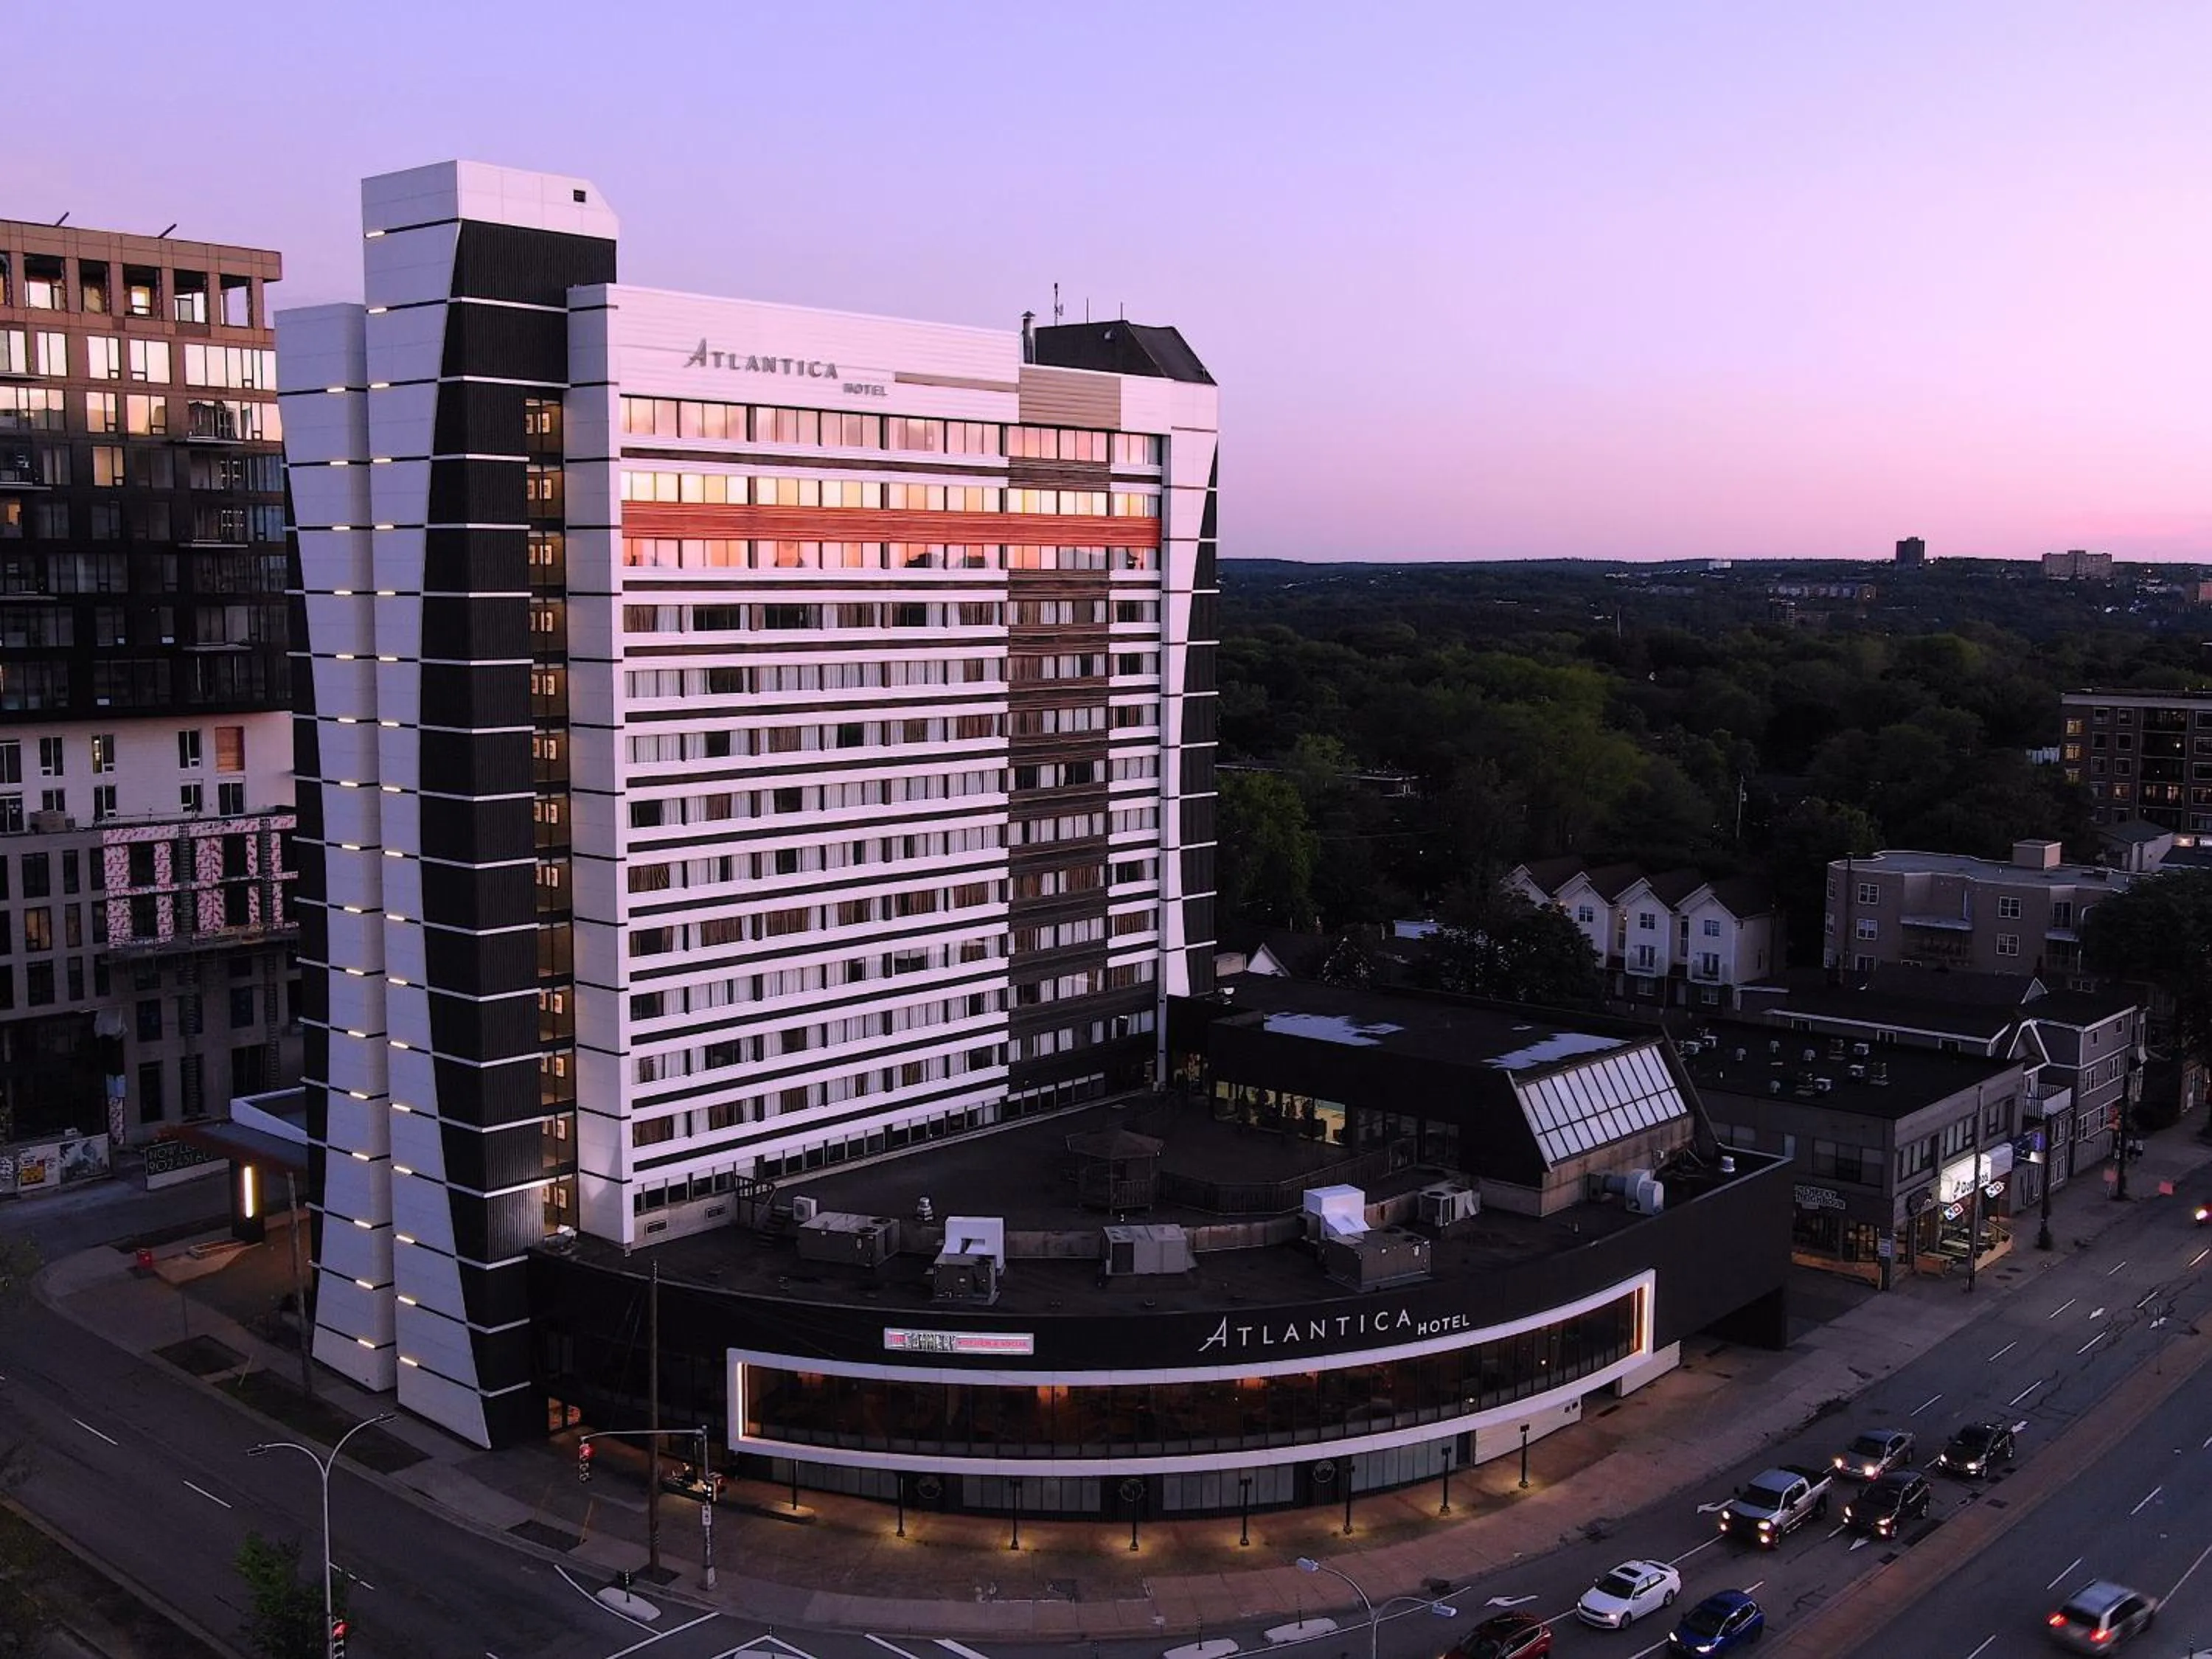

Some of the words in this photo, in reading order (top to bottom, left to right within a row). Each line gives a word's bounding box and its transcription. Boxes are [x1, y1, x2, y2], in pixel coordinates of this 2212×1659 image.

[684, 337, 838, 379] ATLANTICA
[843, 383, 888, 396] HOTEL
[1198, 1310, 1411, 1351] ATLANTICA
[1418, 1314, 1470, 1335] HOTEL
